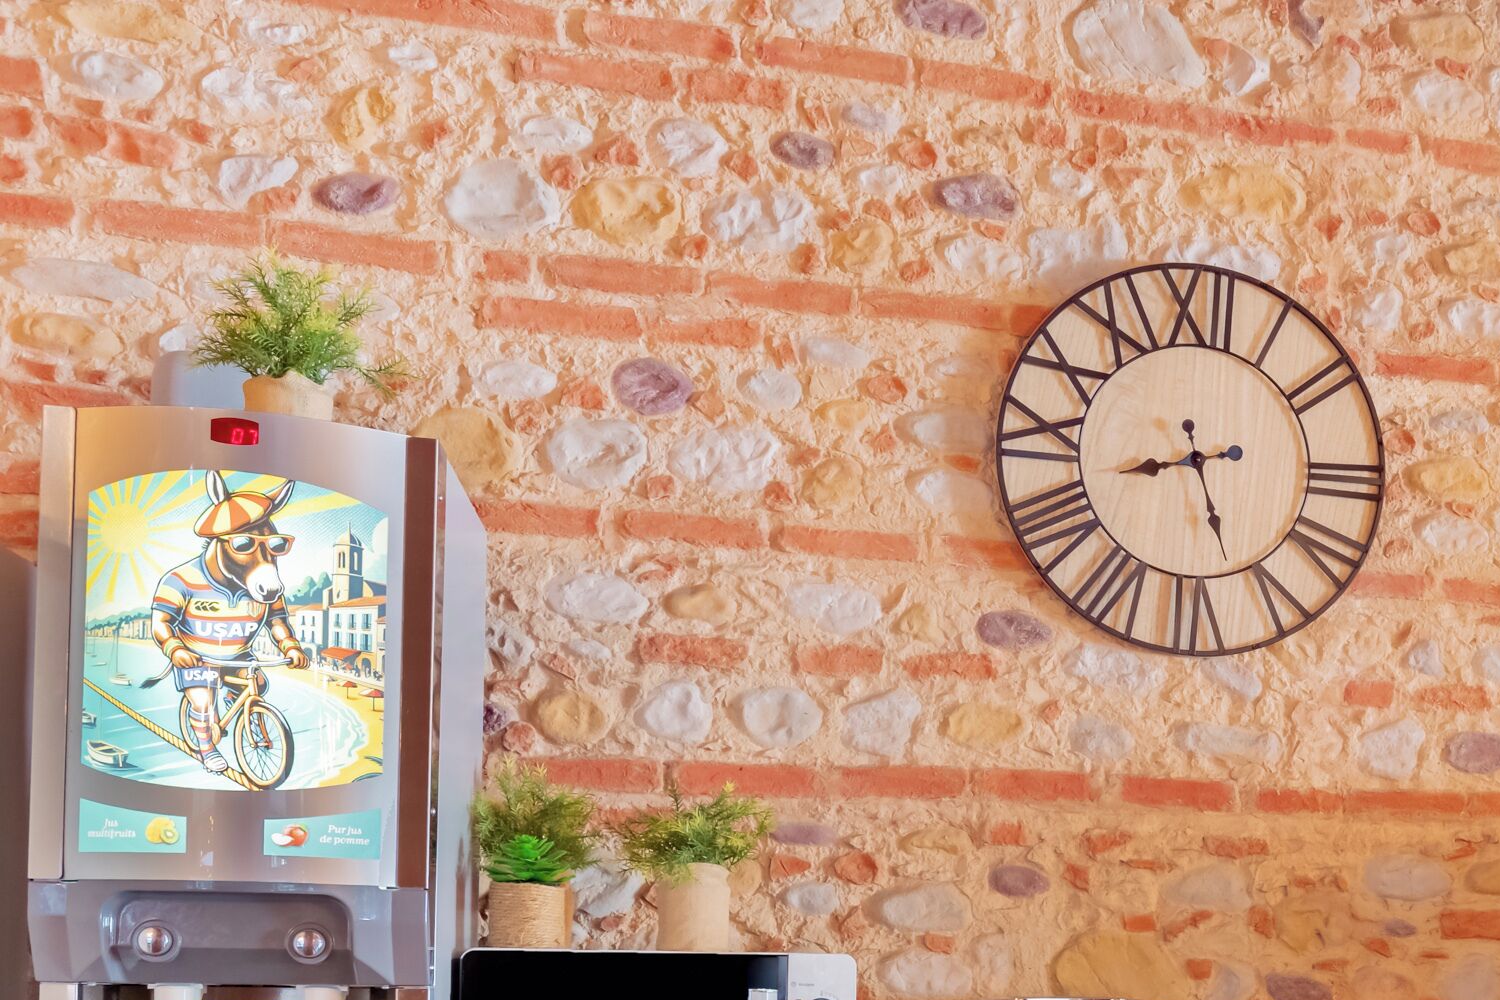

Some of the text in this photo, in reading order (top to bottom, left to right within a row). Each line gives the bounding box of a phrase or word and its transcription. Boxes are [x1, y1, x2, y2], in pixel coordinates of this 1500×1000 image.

[1072, 273, 1161, 369] XI
[1161, 266, 1235, 353] XII
[1254, 300, 1295, 369] I
[1021, 327, 1111, 408] X
[1285, 355, 1360, 415] II
[1000, 394, 1081, 462] IX
[1308, 462, 1383, 501] III
[1009, 479, 1102, 575] VIII
[1289, 514, 1369, 590] IV
[1071, 545, 1148, 641] VII
[1172, 575, 1226, 655] VI
[1250, 562, 1314, 637] V
[195, 621, 259, 637] USAP
[184, 670, 219, 681] USAP
[87, 829, 136, 839] multifruits
[319, 835, 370, 846] de pomme
[328, 824, 362, 836] Pur jus
